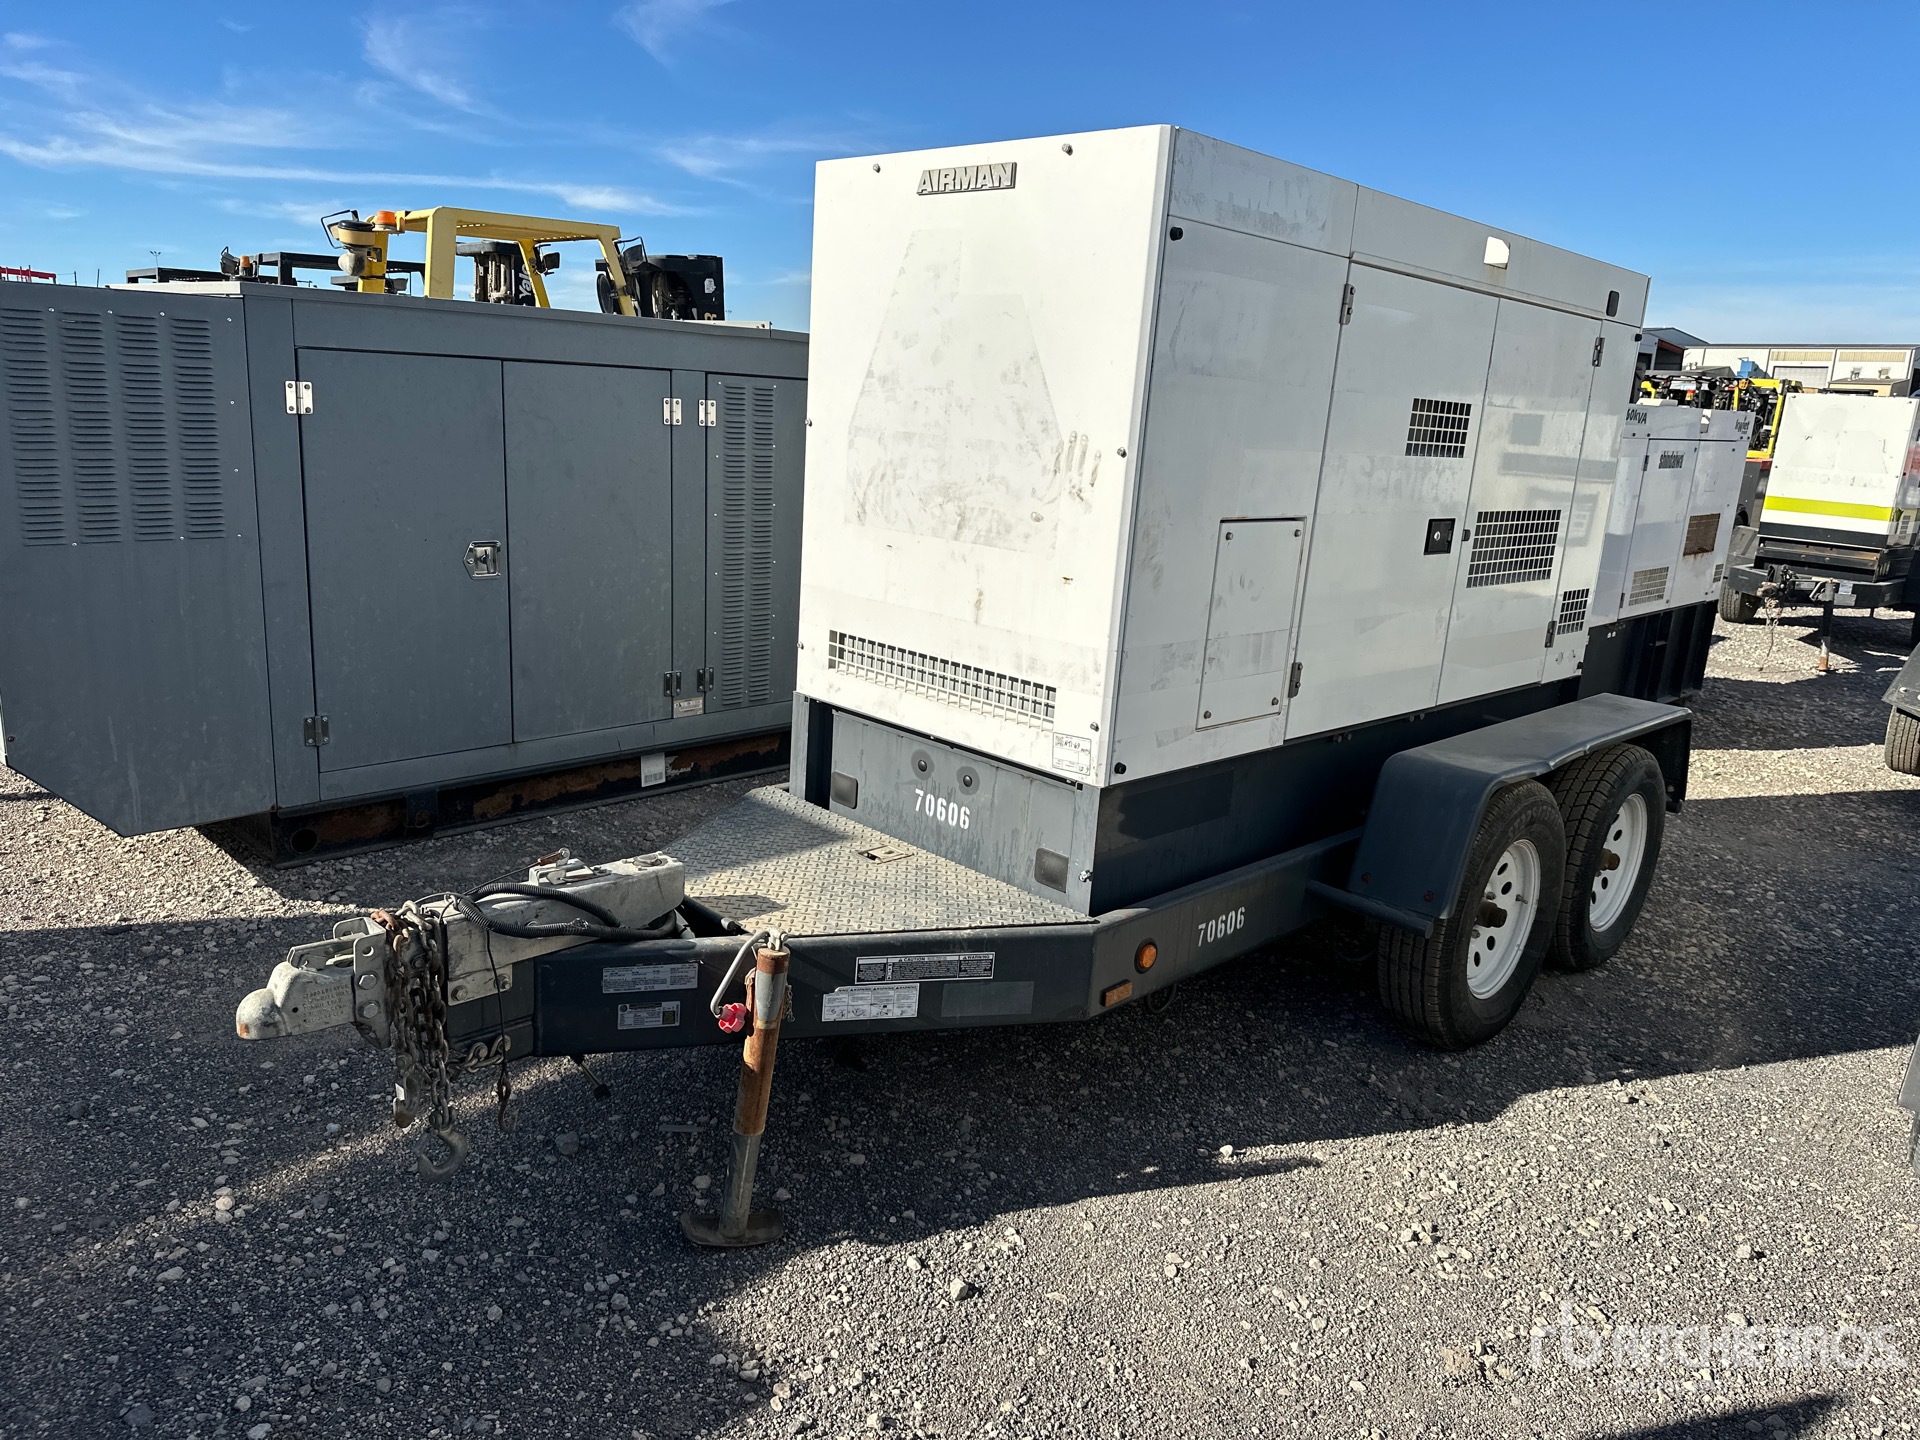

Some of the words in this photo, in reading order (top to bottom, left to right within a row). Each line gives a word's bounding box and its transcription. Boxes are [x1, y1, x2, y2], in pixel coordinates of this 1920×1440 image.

[917, 163, 1013, 194] AIRMAN
[915, 788, 970, 830] 70606
[1198, 906, 1245, 947] 70606
